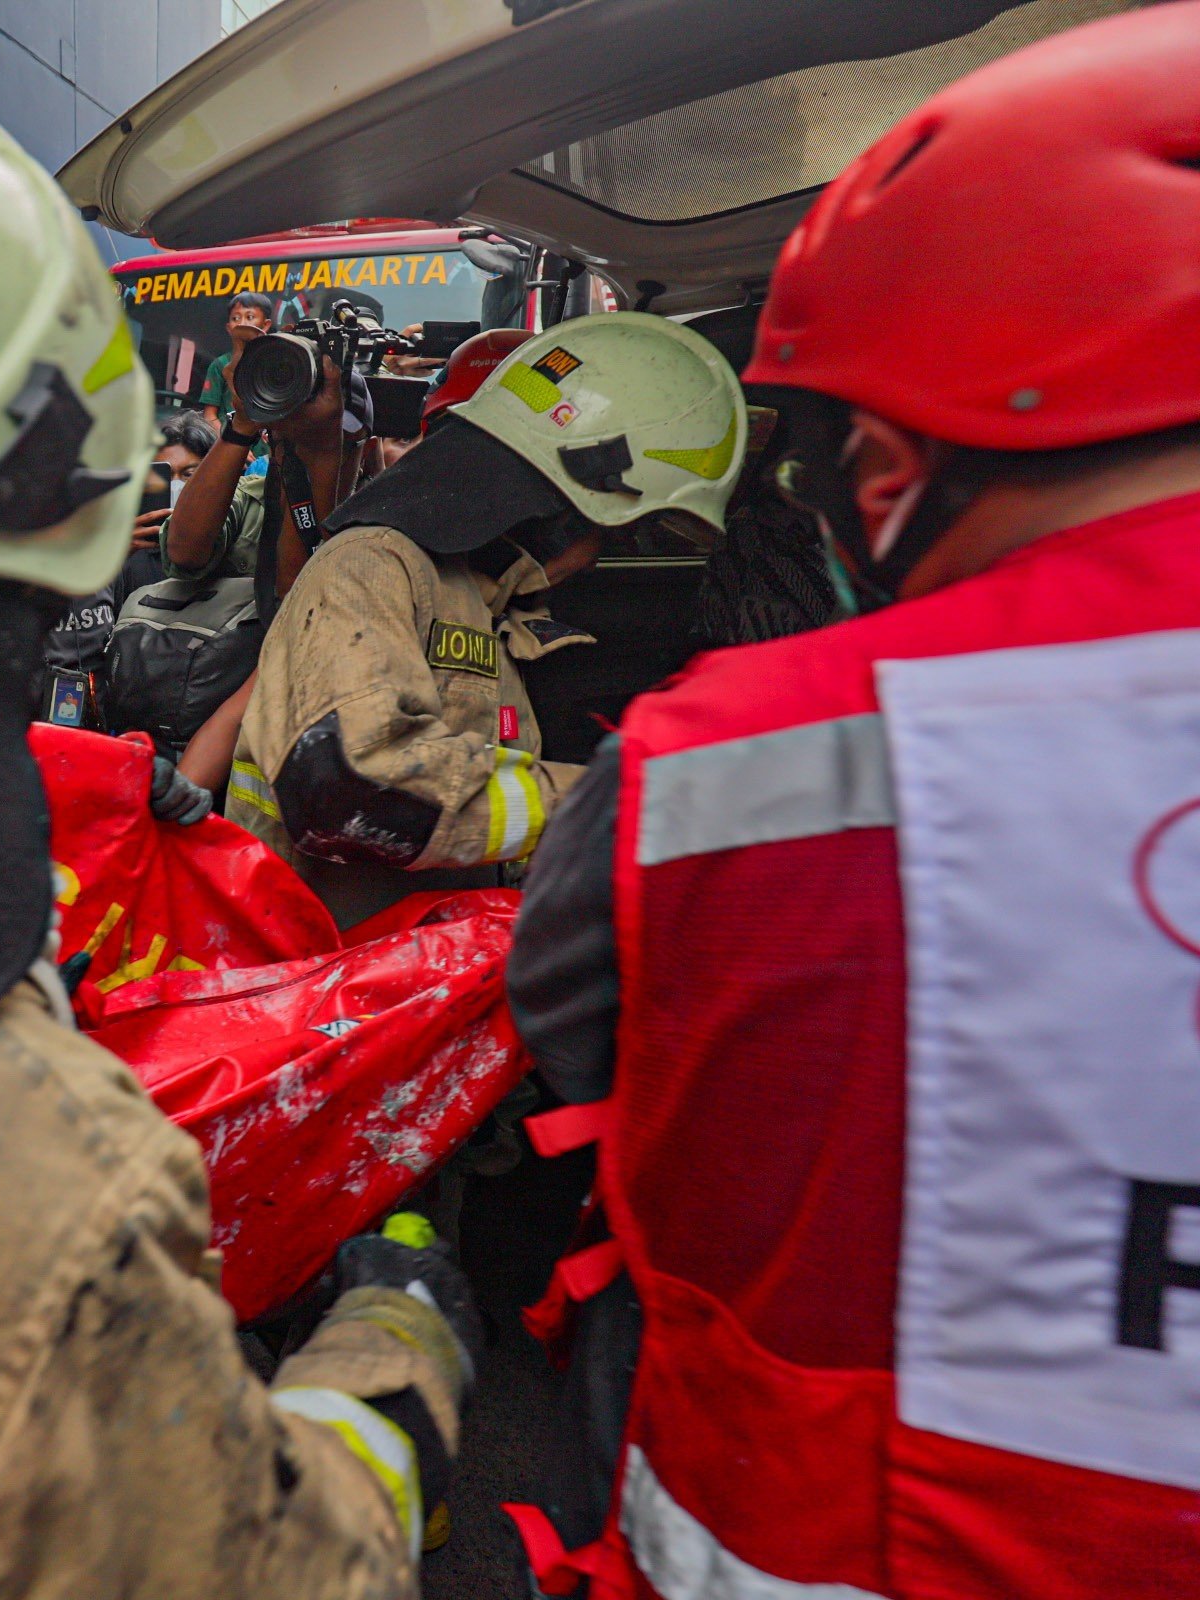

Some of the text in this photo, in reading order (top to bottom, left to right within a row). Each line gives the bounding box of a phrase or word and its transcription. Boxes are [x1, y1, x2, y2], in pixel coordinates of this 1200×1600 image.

[134, 255, 448, 305] PEMADAM JAKARTA
[537, 349, 580, 377] JONI
[299, 506, 312, 529] PRO
[436, 628, 493, 668] JONI
